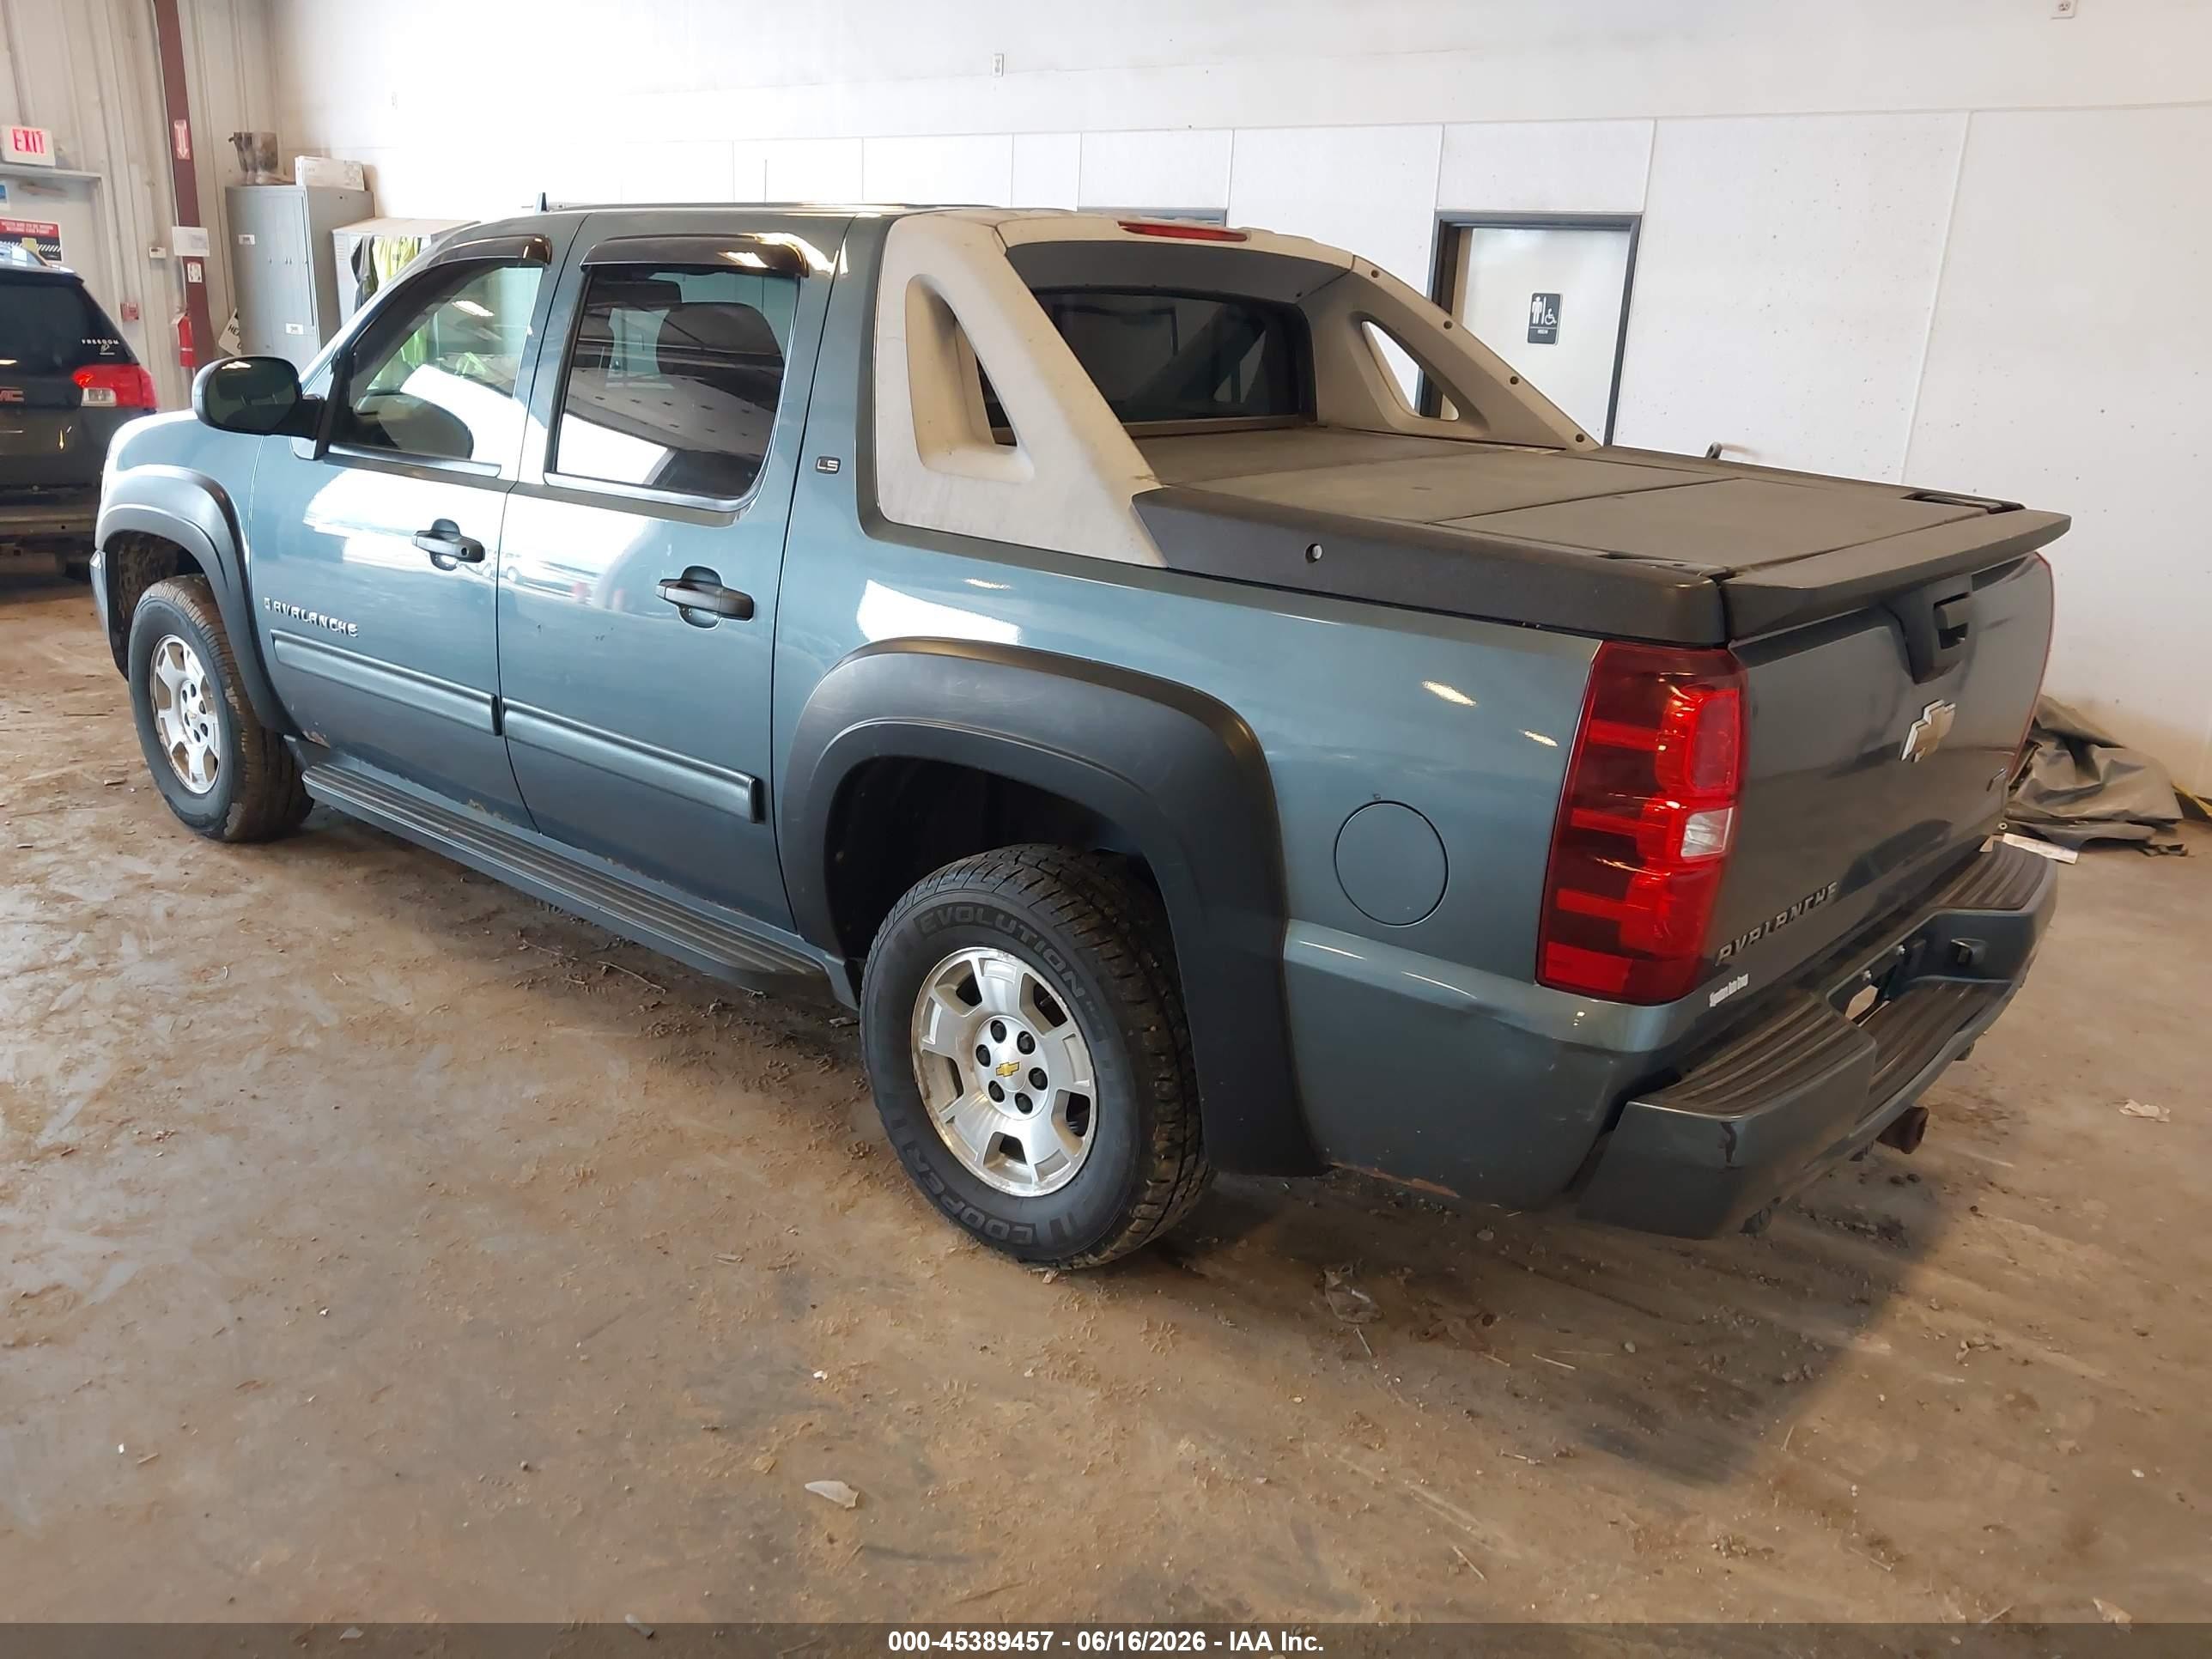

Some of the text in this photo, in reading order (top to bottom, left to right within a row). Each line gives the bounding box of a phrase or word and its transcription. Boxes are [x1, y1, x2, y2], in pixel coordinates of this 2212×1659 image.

[13, 128, 45, 154] EXIT
[817, 459, 839, 471] LS
[273, 600, 359, 637] AVALANCHE
[1715, 880, 1838, 967] AVALANCHE
[919, 905, 1085, 999] EVOLUTION
